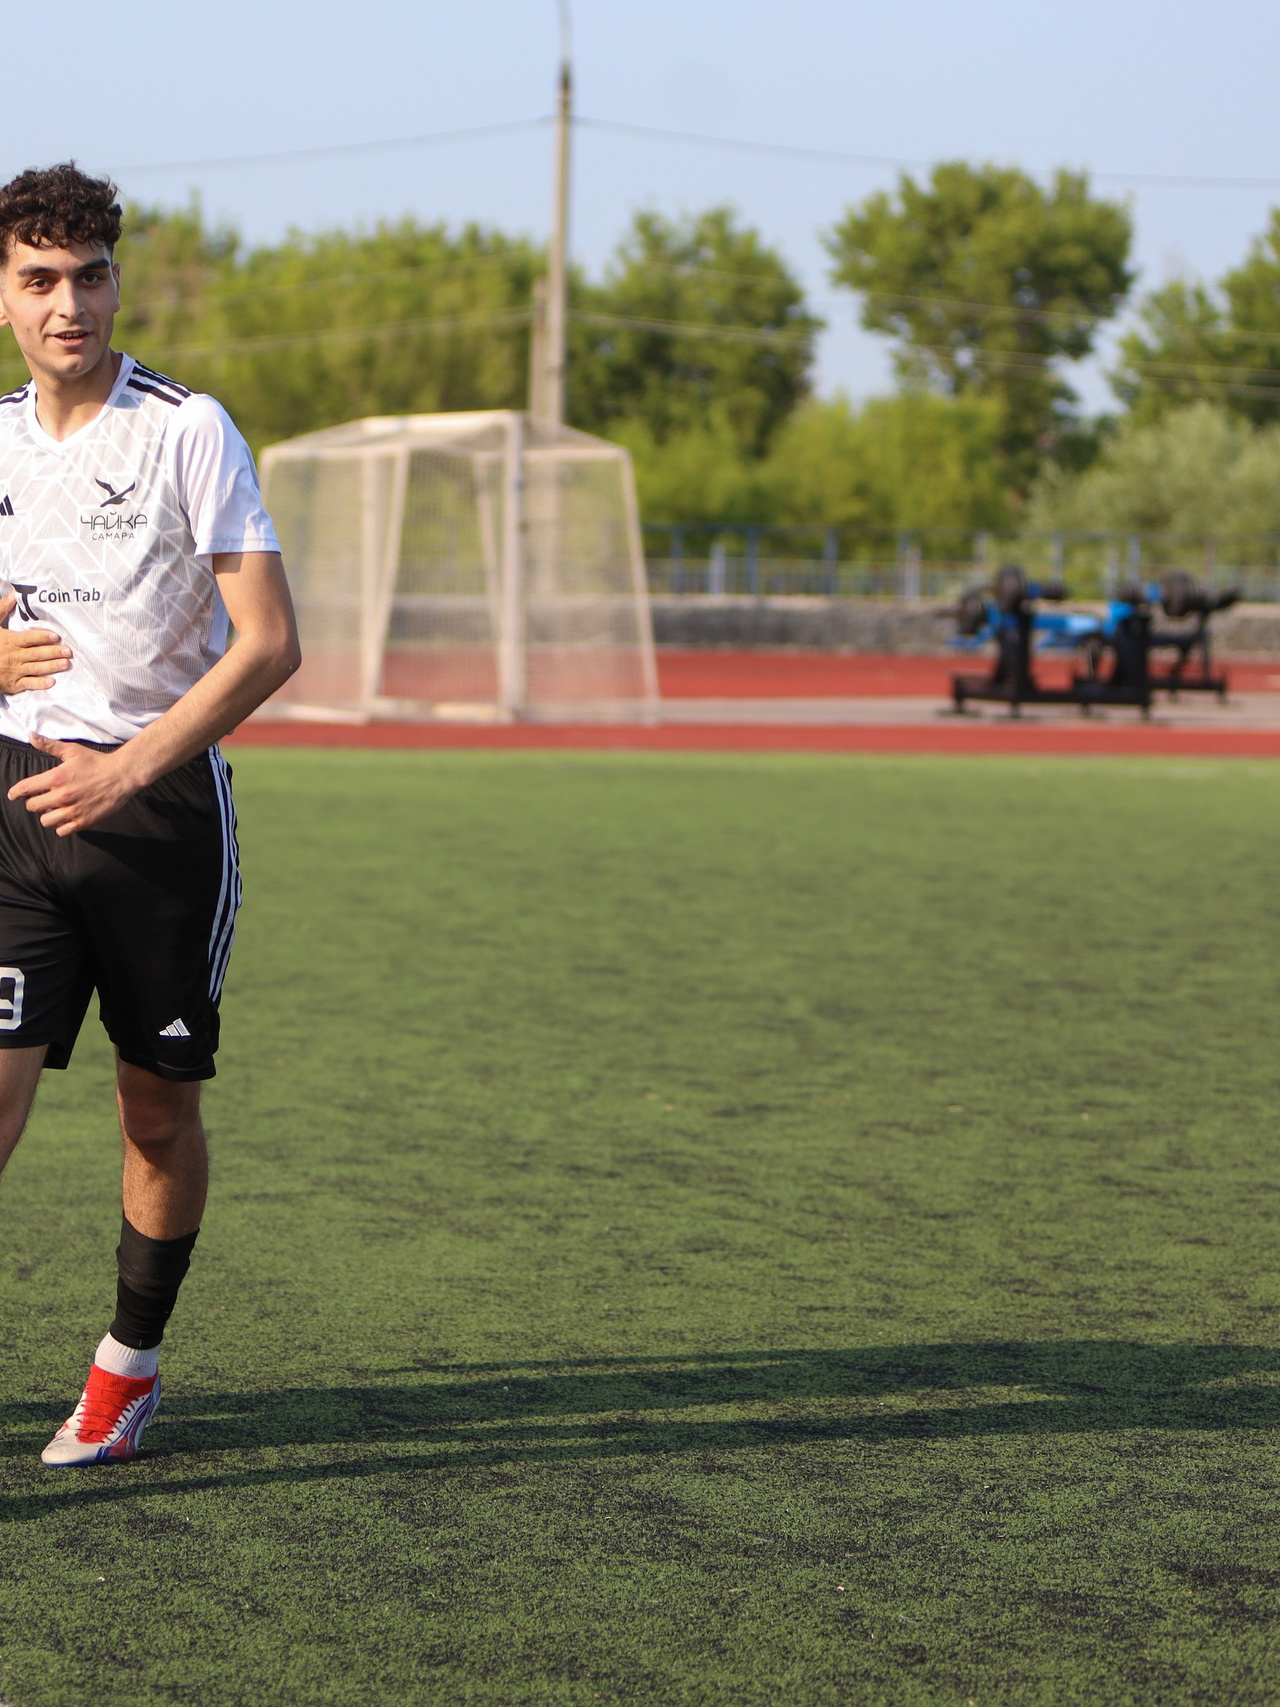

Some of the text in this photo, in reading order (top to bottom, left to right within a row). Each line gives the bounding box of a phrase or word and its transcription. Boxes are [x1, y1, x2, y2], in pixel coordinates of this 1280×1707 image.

[80, 511, 148, 531] ЧАЙКА
[92, 532, 135, 541] САМАРА
[38, 587, 101, 603] Coin Tab
